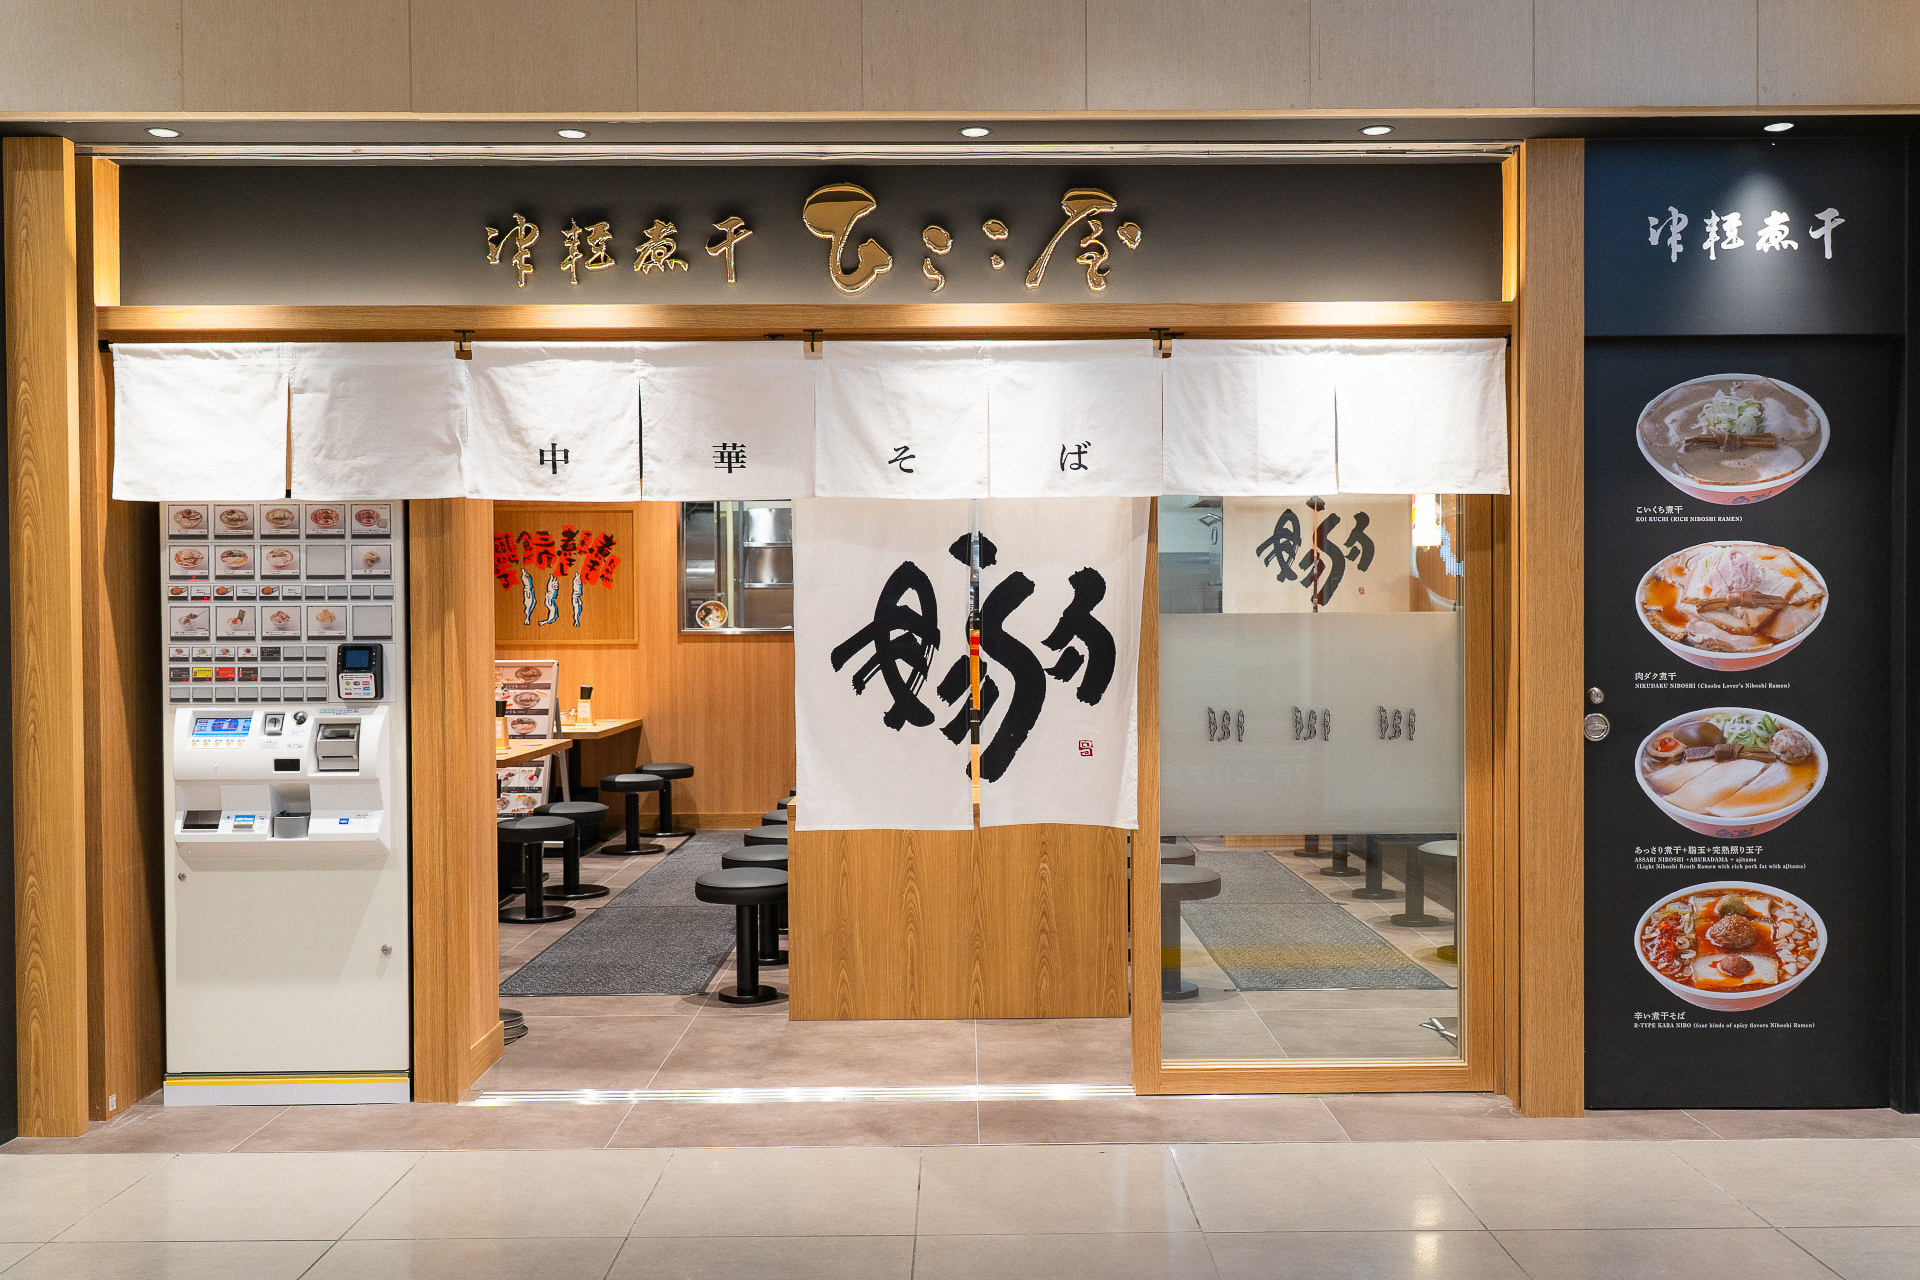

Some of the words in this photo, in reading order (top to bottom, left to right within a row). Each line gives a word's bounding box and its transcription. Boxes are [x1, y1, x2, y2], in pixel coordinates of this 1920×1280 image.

[538, 441, 1092, 475] 中華そば
[1636, 505, 1683, 514] こいくち煮干
[1635, 672, 1676, 681] 肉ダク煮干
[1633, 1011, 1686, 1021] 辛い煮干そば
